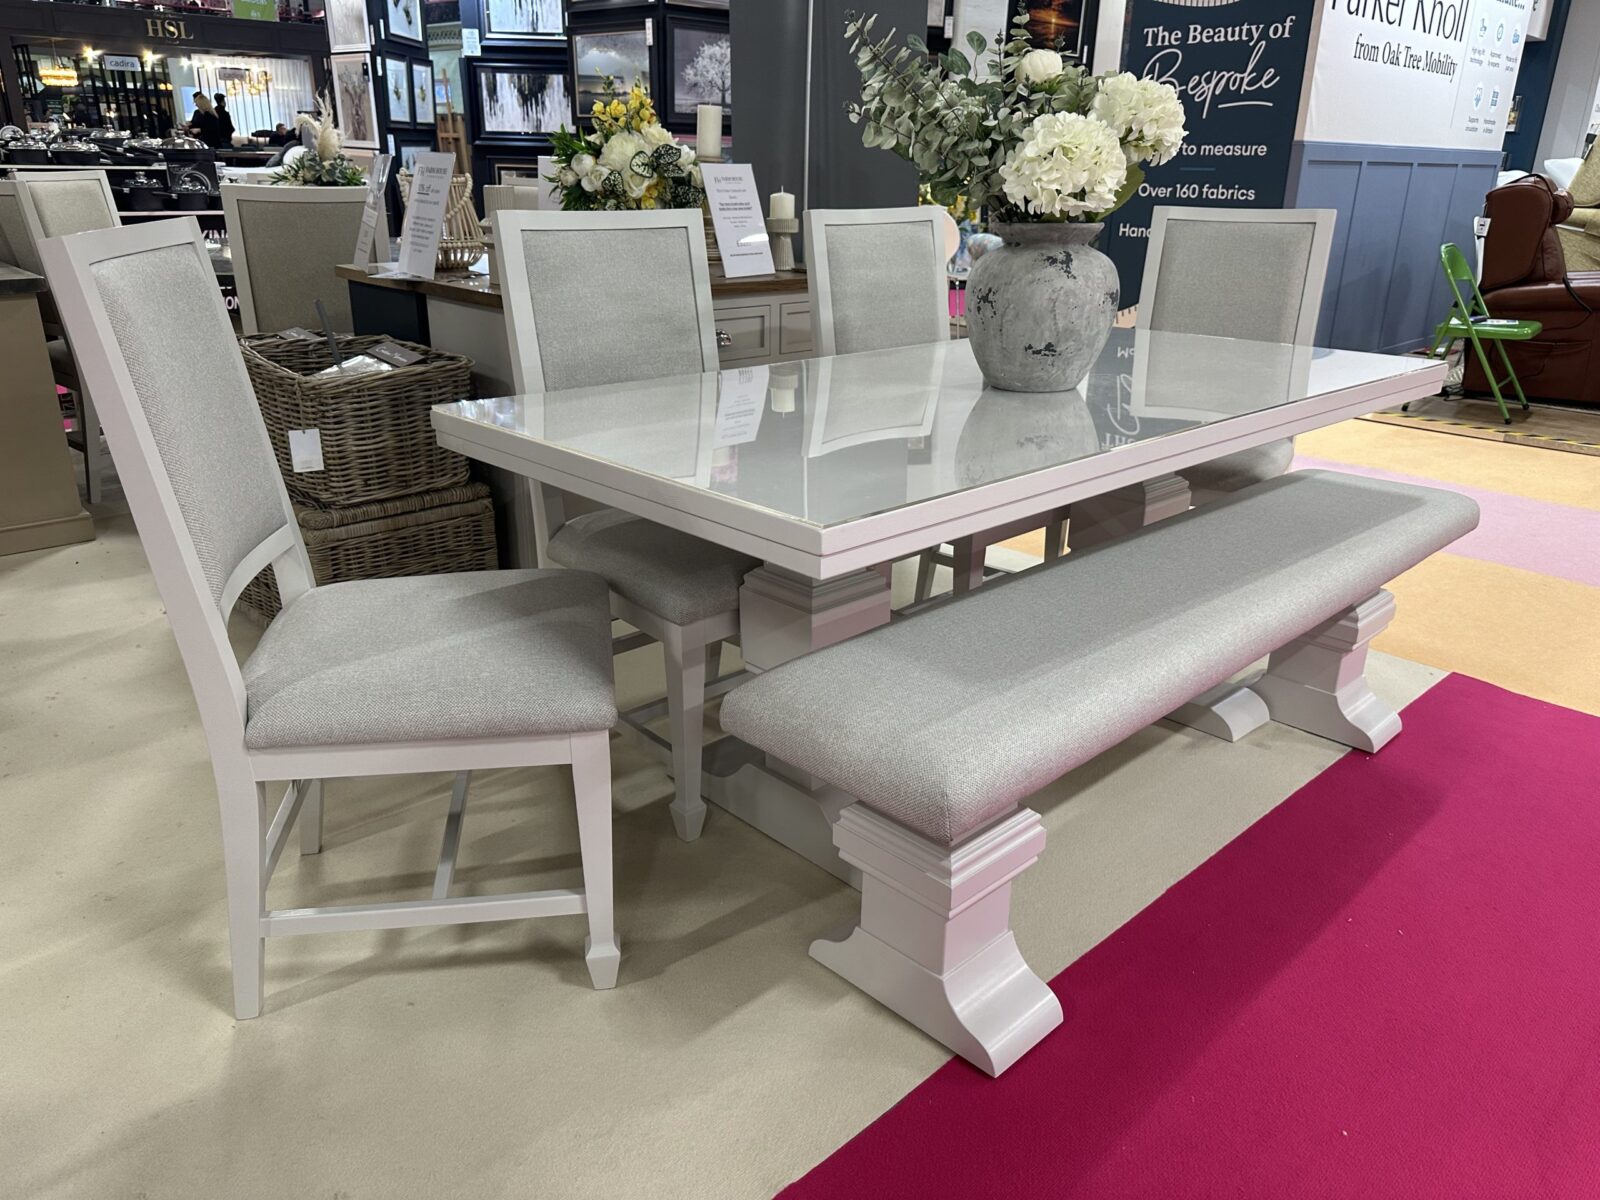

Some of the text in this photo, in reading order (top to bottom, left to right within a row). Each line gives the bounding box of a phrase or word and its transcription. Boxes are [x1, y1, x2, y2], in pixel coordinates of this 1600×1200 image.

[146, 18, 195, 39] HSL
[1143, 15, 1296, 47] The Beauty of
[109, 59, 135, 68] cadira
[1353, 33, 1458, 83] from Oak Tree Mobility
[1142, 40, 1281, 119] Bespoke
[1200, 144, 1268, 157] measure
[1138, 183, 1256, 200] Over 160 fabrics
